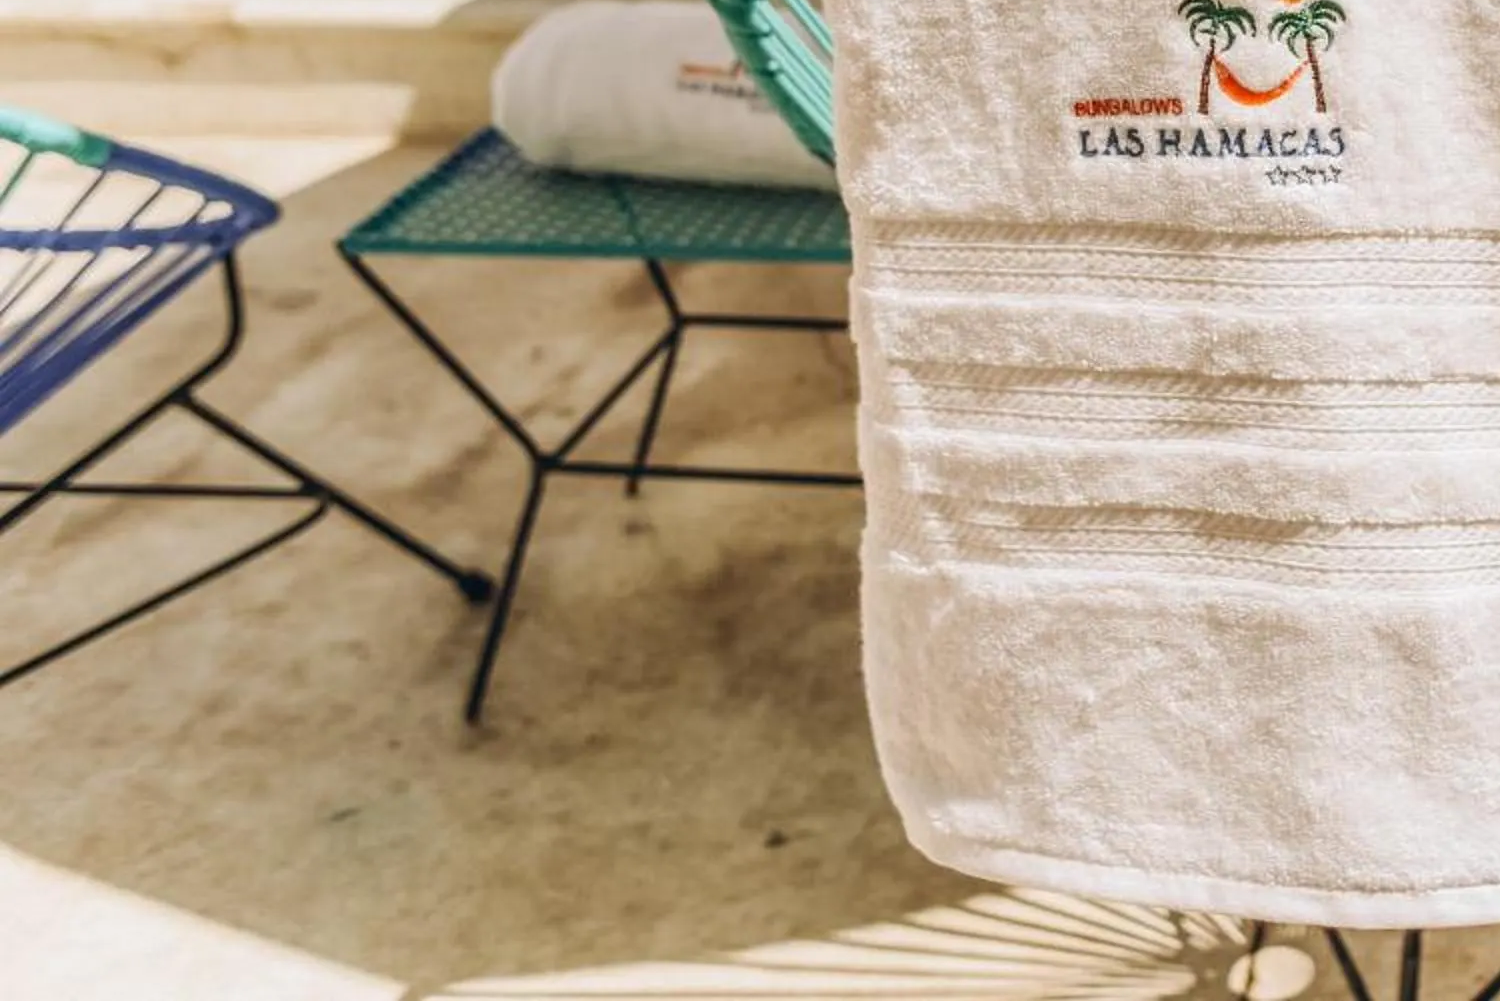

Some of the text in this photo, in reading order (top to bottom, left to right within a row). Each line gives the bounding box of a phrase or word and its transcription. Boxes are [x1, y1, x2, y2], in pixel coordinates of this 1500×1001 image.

[1073, 98, 1185, 117] BUNGALOWS
[1078, 127, 1346, 158] LAS HAMACAS
